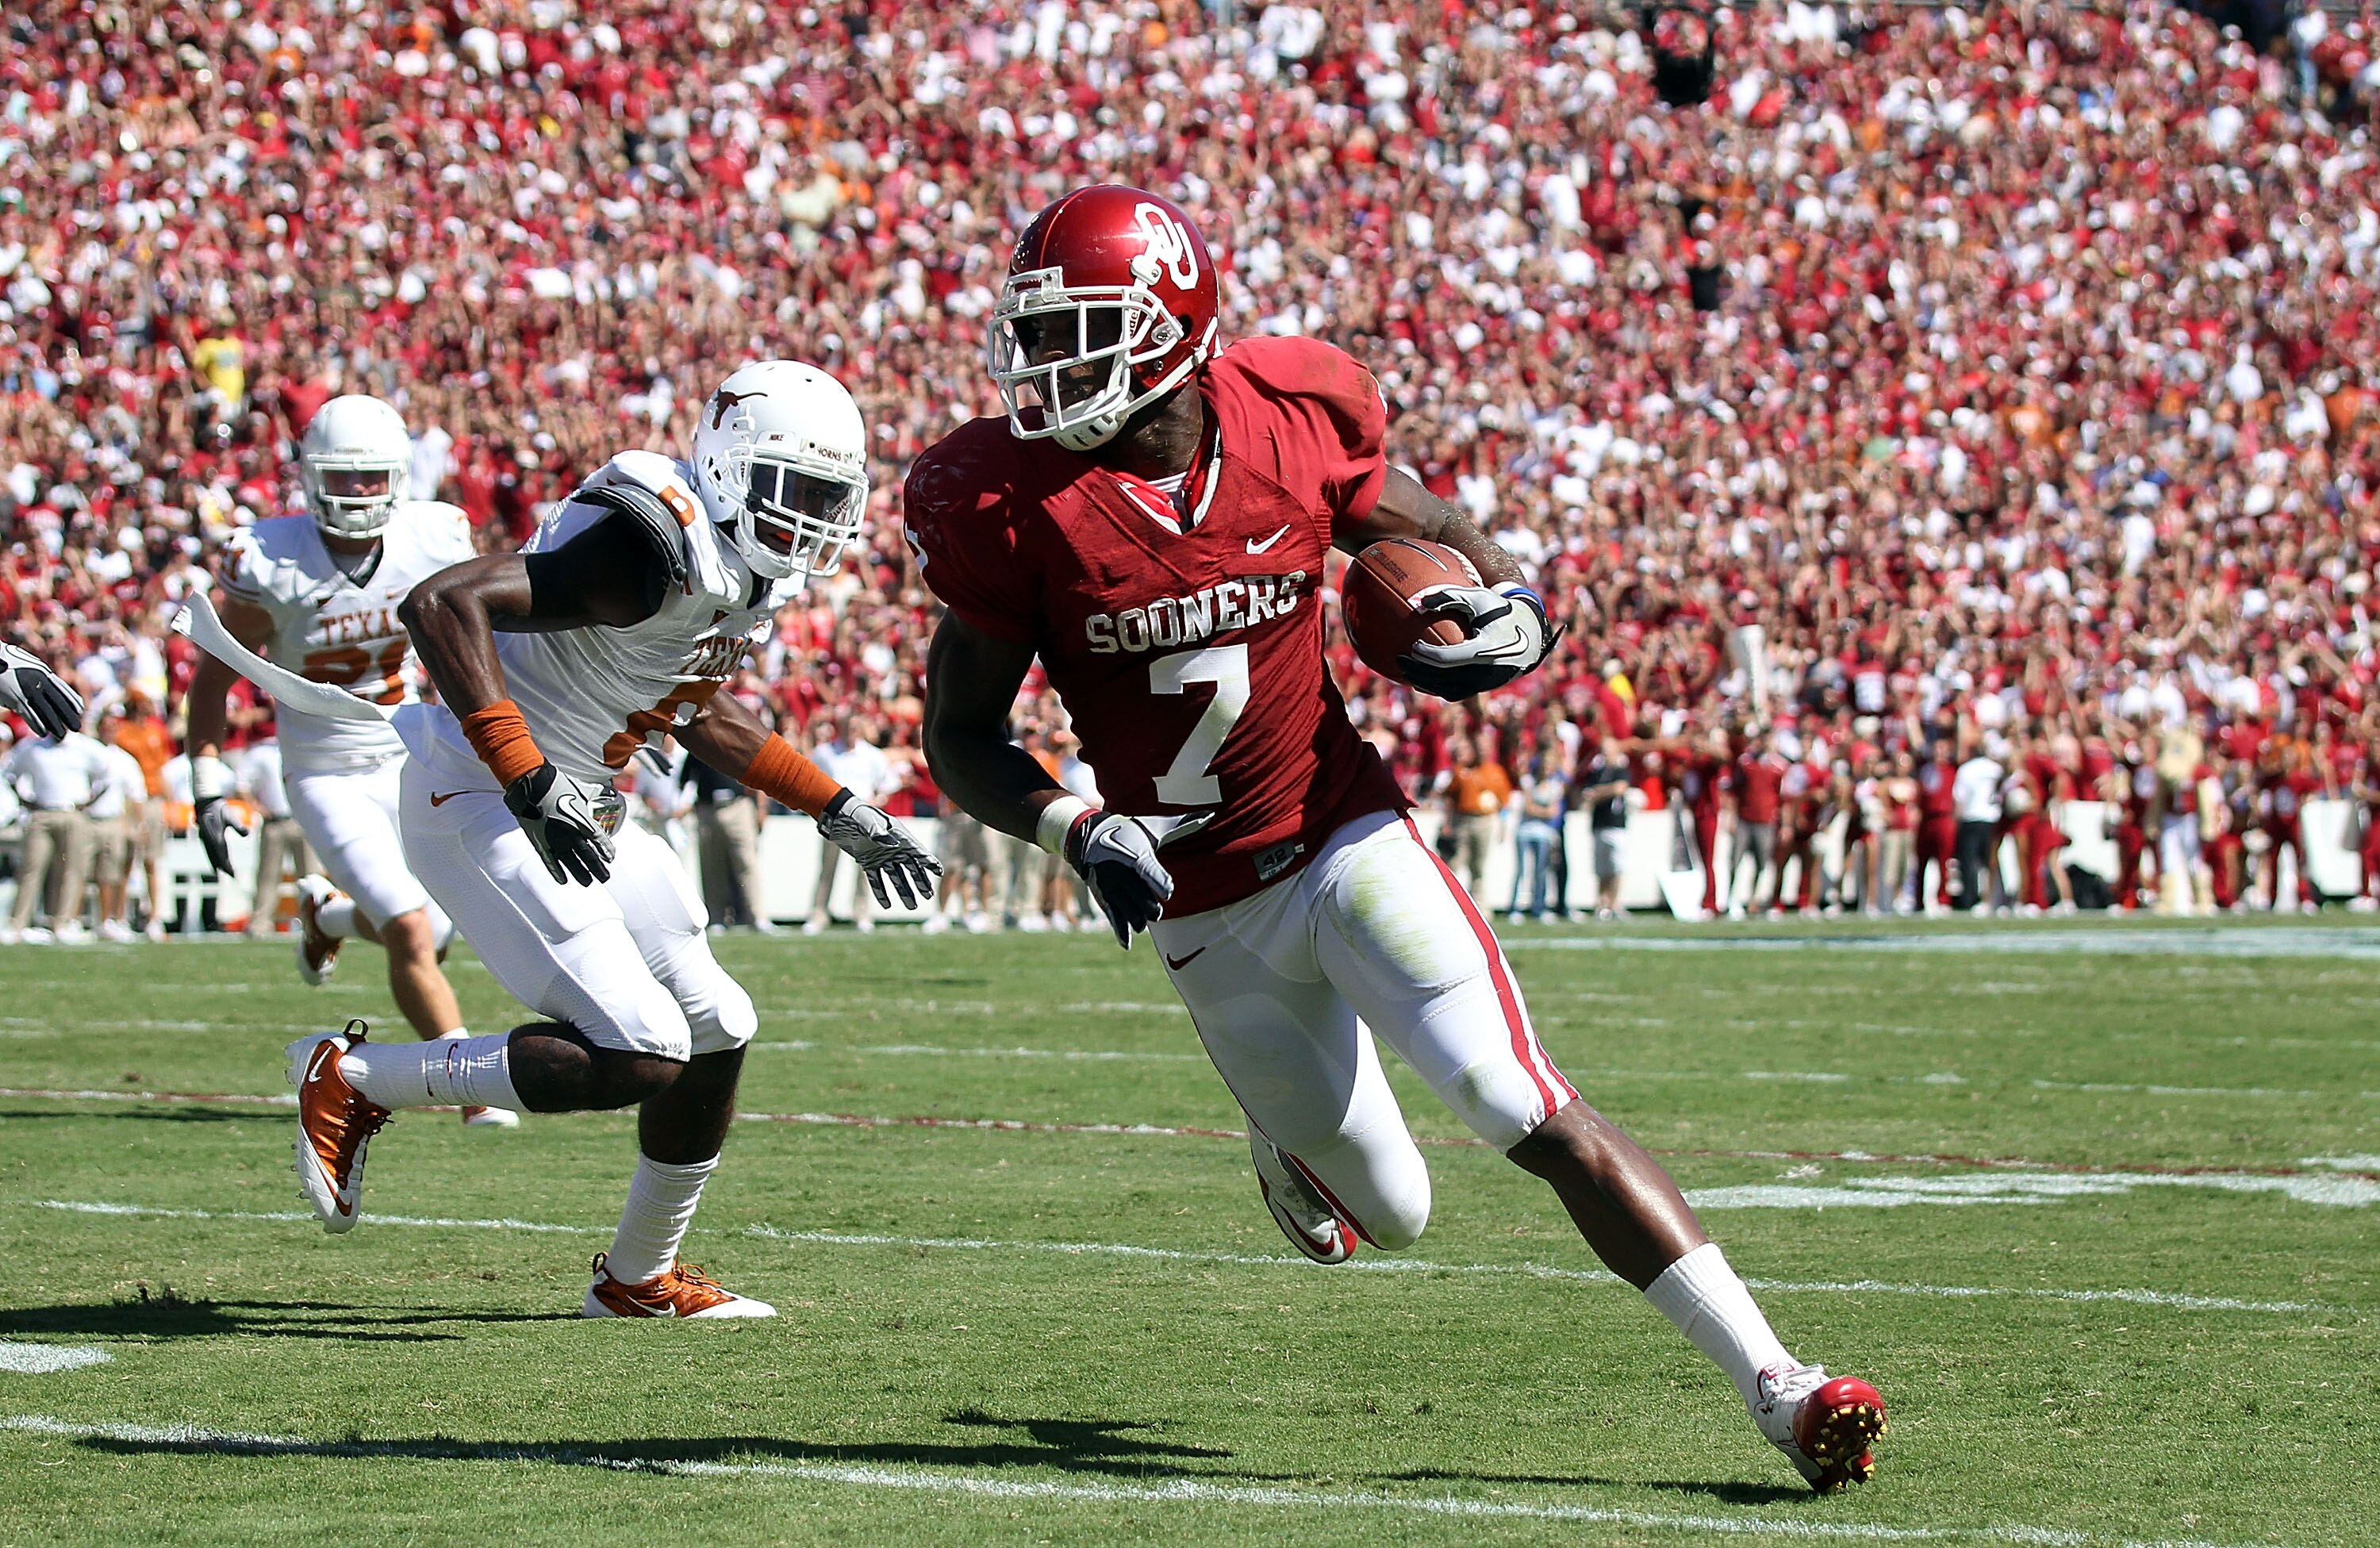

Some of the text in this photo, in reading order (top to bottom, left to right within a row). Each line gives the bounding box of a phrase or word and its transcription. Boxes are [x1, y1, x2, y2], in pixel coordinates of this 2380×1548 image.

[319, 605, 407, 646] TEXA
[1084, 569, 1307, 655] SOONERS
[1149, 643, 1251, 805] 7
